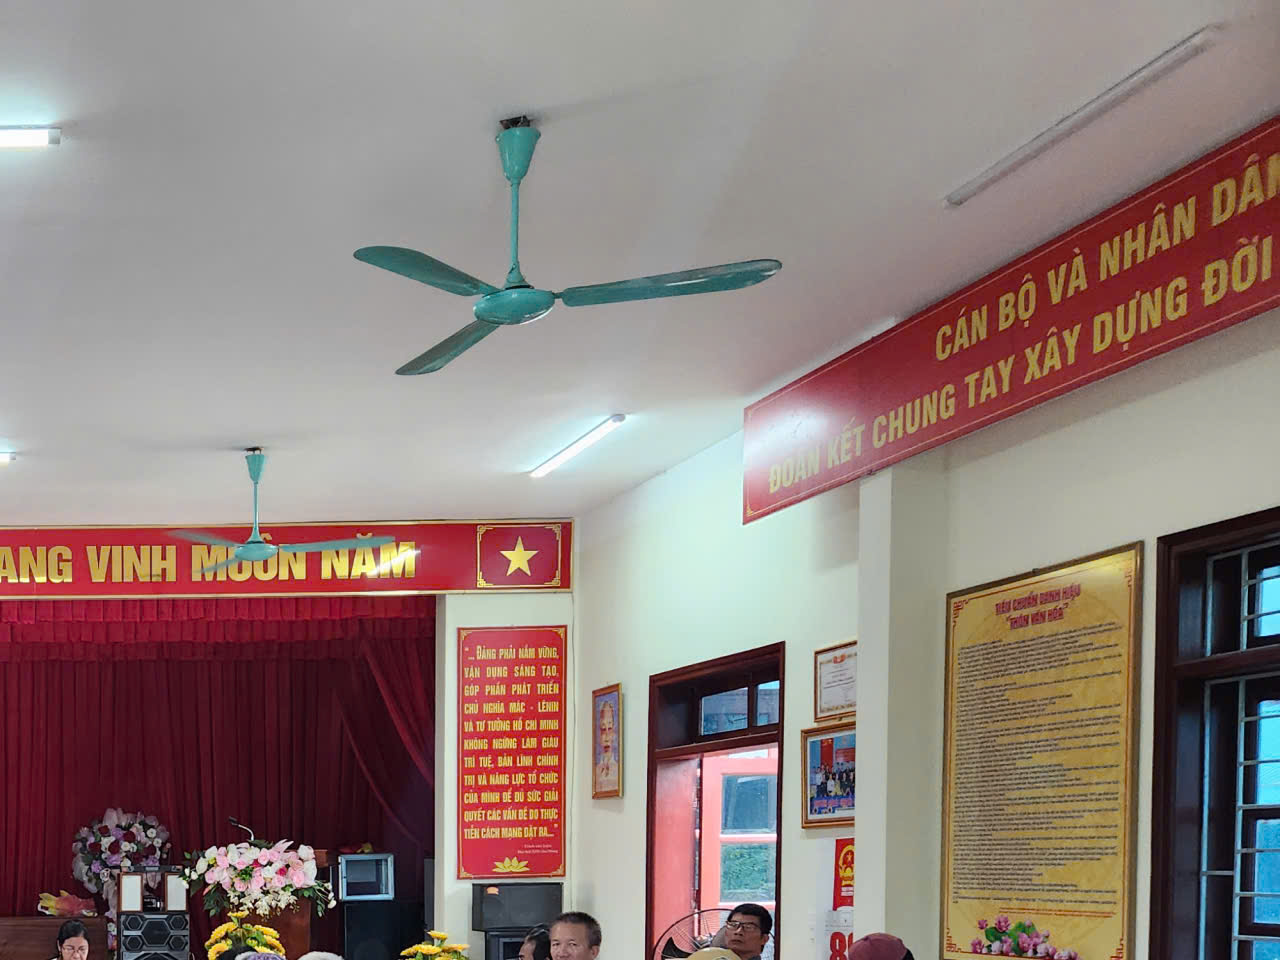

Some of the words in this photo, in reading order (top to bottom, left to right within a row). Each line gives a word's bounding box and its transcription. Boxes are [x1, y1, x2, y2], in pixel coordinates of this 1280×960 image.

[935, 306, 988, 362] CÁN
[998, 272, 1037, 331] BỘ
[1048, 247, 1087, 304] VÀ
[1098, 195, 1196, 281] NHÂN
[827, 414, 865, 470] KẾT
[872, 385, 956, 448] CHUNG
[965, 354, 1014, 409] TAY
[1023, 322, 1081, 385] XÂY
[1092, 276, 1189, 354] DỰNG
[1201, 235, 1272, 307] ĐỜI
[87, 545, 176, 583] VINH
[191, 533, 306, 582] MUÔN
[321, 533, 416, 580] NĂM
[464, 737, 488, 750] KHÔNG
[539, 719, 559, 731] MINH
